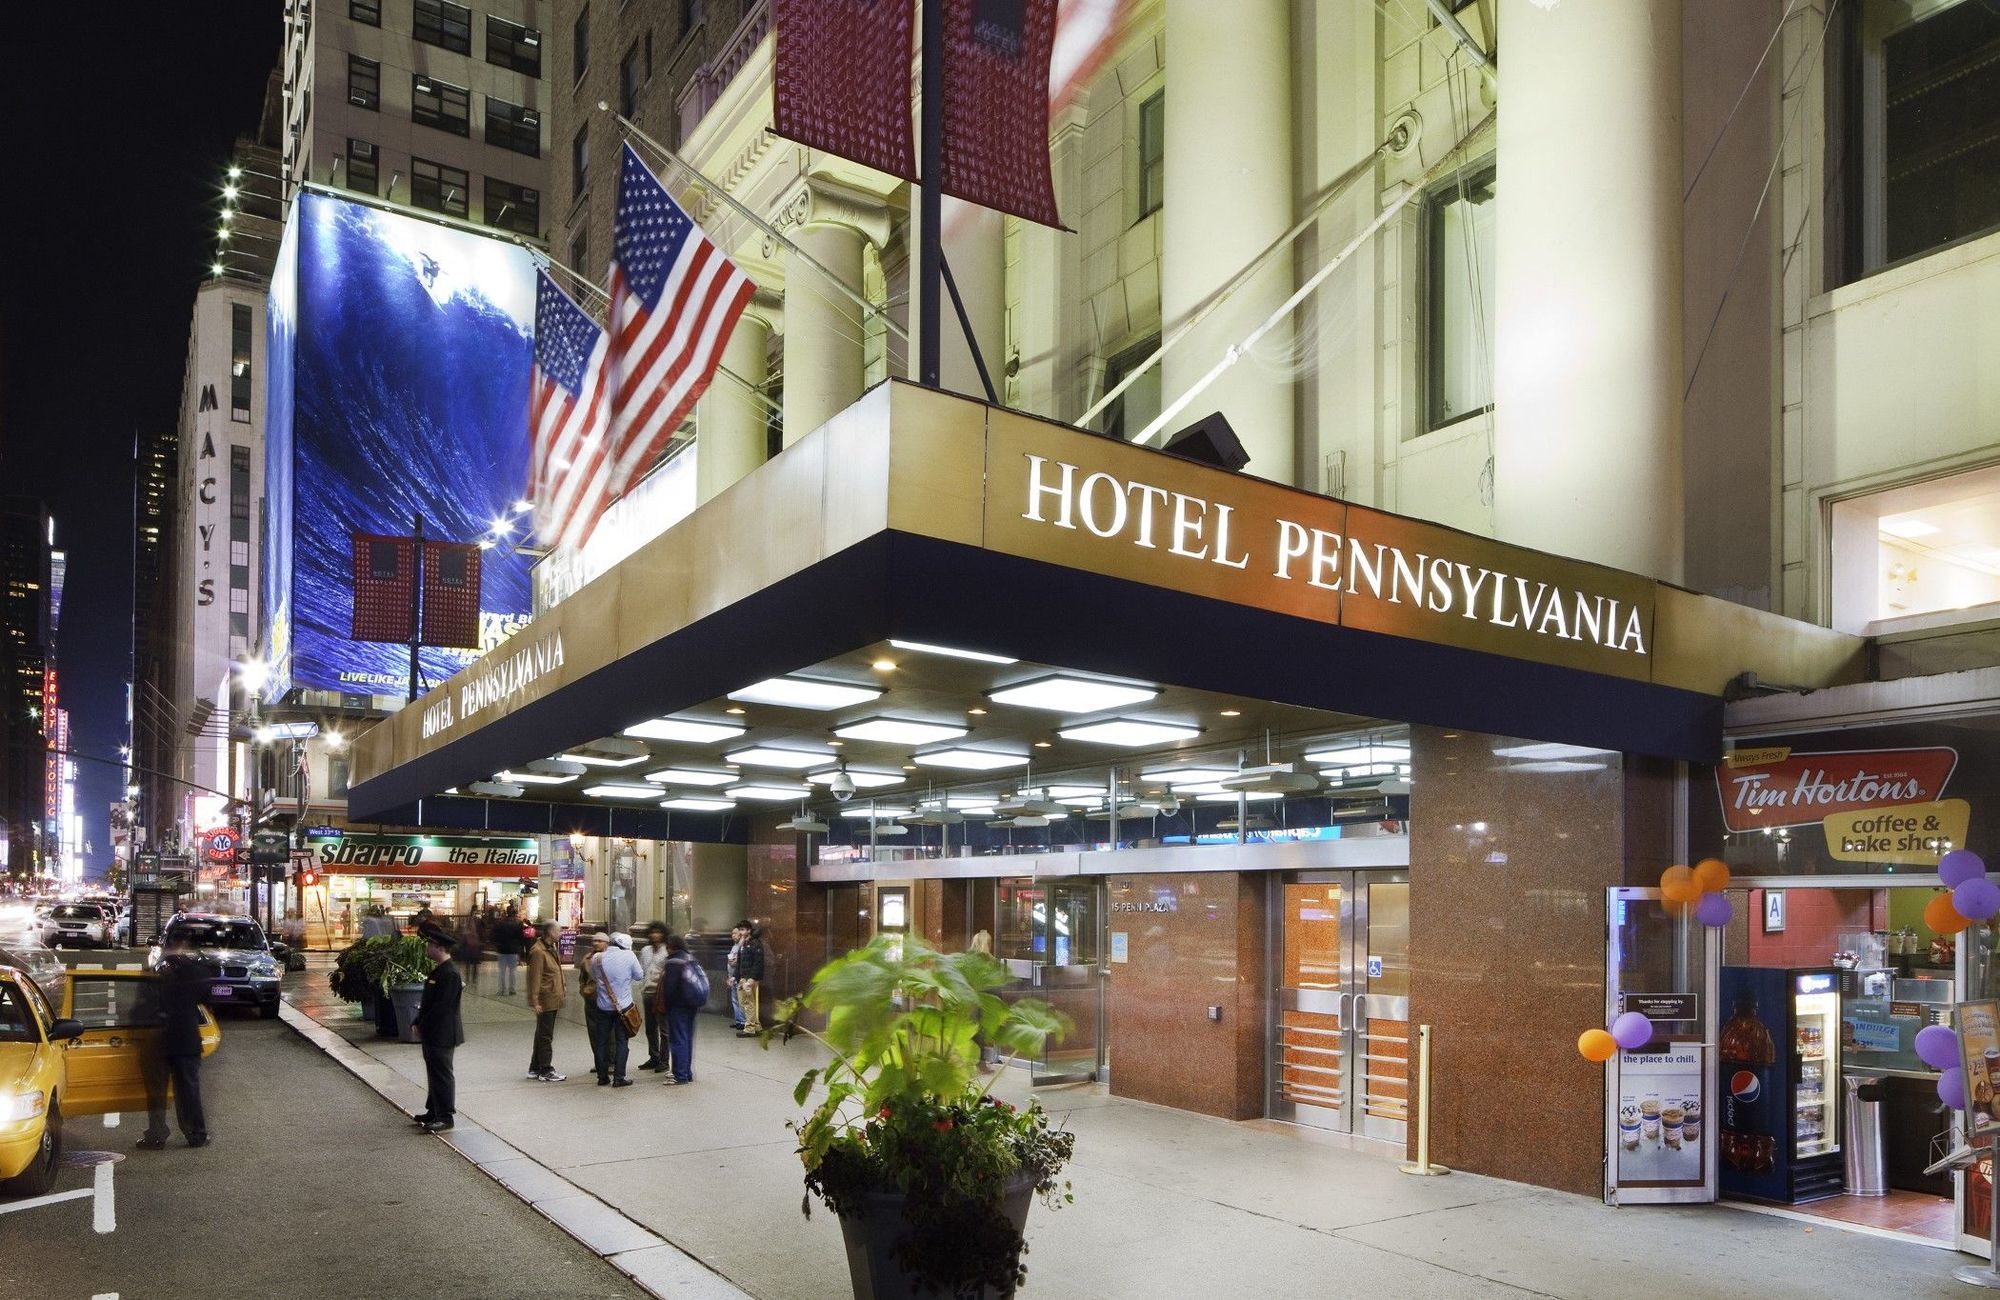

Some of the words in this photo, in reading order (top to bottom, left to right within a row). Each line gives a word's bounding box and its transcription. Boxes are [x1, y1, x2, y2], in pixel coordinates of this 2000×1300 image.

[1021, 453, 1249, 570] HOTEL
[1272, 518, 1647, 655] PENNSYLVANIA
[422, 696, 454, 739] HOTEL
[461, 626, 564, 720] PENNSYLVANIA
[48, 671, 57, 728] ERNST
[48, 741, 56, 749] &
[1760, 751, 1783, 760] Fresh
[47, 759, 57, 817] YOUNG
[1733, 773, 1786, 809] Tim
[1792, 768, 1918, 805] Hortons
[205, 826, 240, 842] LUGGAGE
[1852, 815, 1917, 834] coffee
[1922, 815, 1940, 832] &
[320, 838, 424, 868] sbarro
[1841, 834, 1891, 853] bake
[1897, 833, 1951, 855] shop
[448, 847, 478, 864] the
[483, 848, 538, 865] Italian
[1111, 902, 1120, 912] 15
[1121, 902, 1142, 912] PENN
[1145, 902, 1169, 912] PLAZA
[1769, 896, 1780, 918] A
[1855, 1023, 1897, 1035] INDULGE
[1623, 1055, 1638, 1063] the
[1640, 1055, 1662, 1065] place
[1676, 1055, 1697, 1063] chill.
